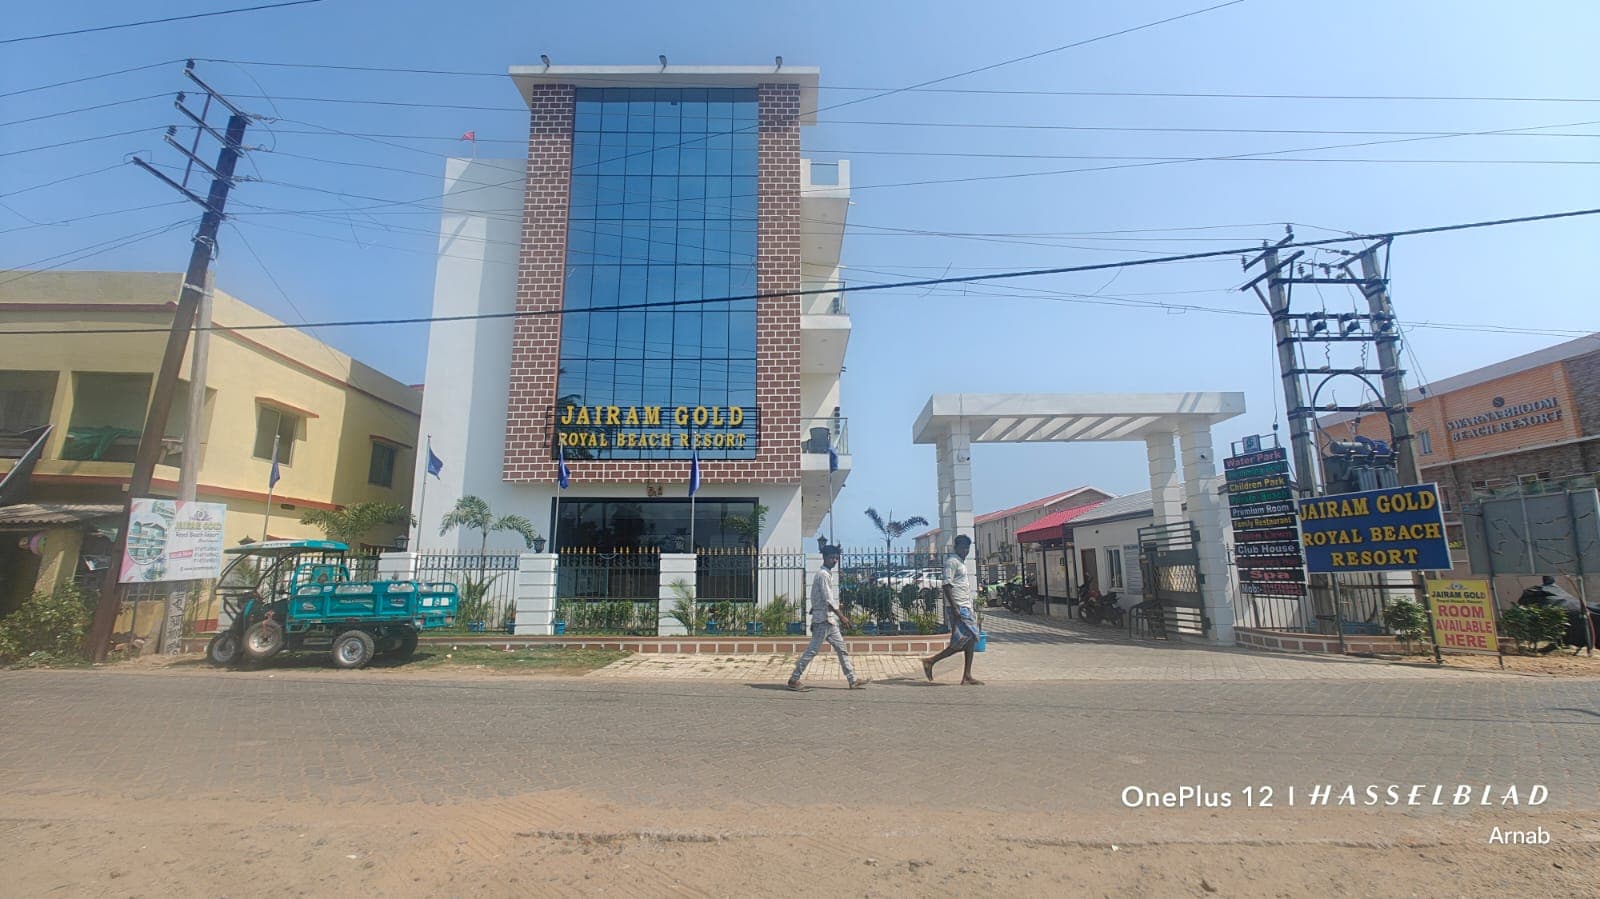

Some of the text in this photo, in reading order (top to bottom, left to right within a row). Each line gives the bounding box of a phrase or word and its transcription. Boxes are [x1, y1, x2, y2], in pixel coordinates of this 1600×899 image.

[561, 405, 744, 426] JAIRAM GOLD
[1452, 409, 1562, 441] BEACH RESORT
[559, 432, 746, 447] ROYAL BEACH RESORT
[1226, 450, 1281, 468] Water Park
[1229, 476, 1285, 493] Children Park
[1232, 504, 1289, 517] Premium Room
[1301, 491, 1435, 520] JAIRAM GOLD
[1303, 528, 1363, 546] ROYAL
[1370, 522, 1442, 541] BEACH
[1238, 544, 1295, 554] Club House
[1331, 548, 1418, 566] RESORT
[1250, 570, 1290, 580] Spa
[1432, 591, 1462, 599] JAIRAM
[1438, 604, 1485, 618] ROOM
[1436, 618, 1493, 633] AVAILABLE
[1444, 634, 1487, 648] HERE
